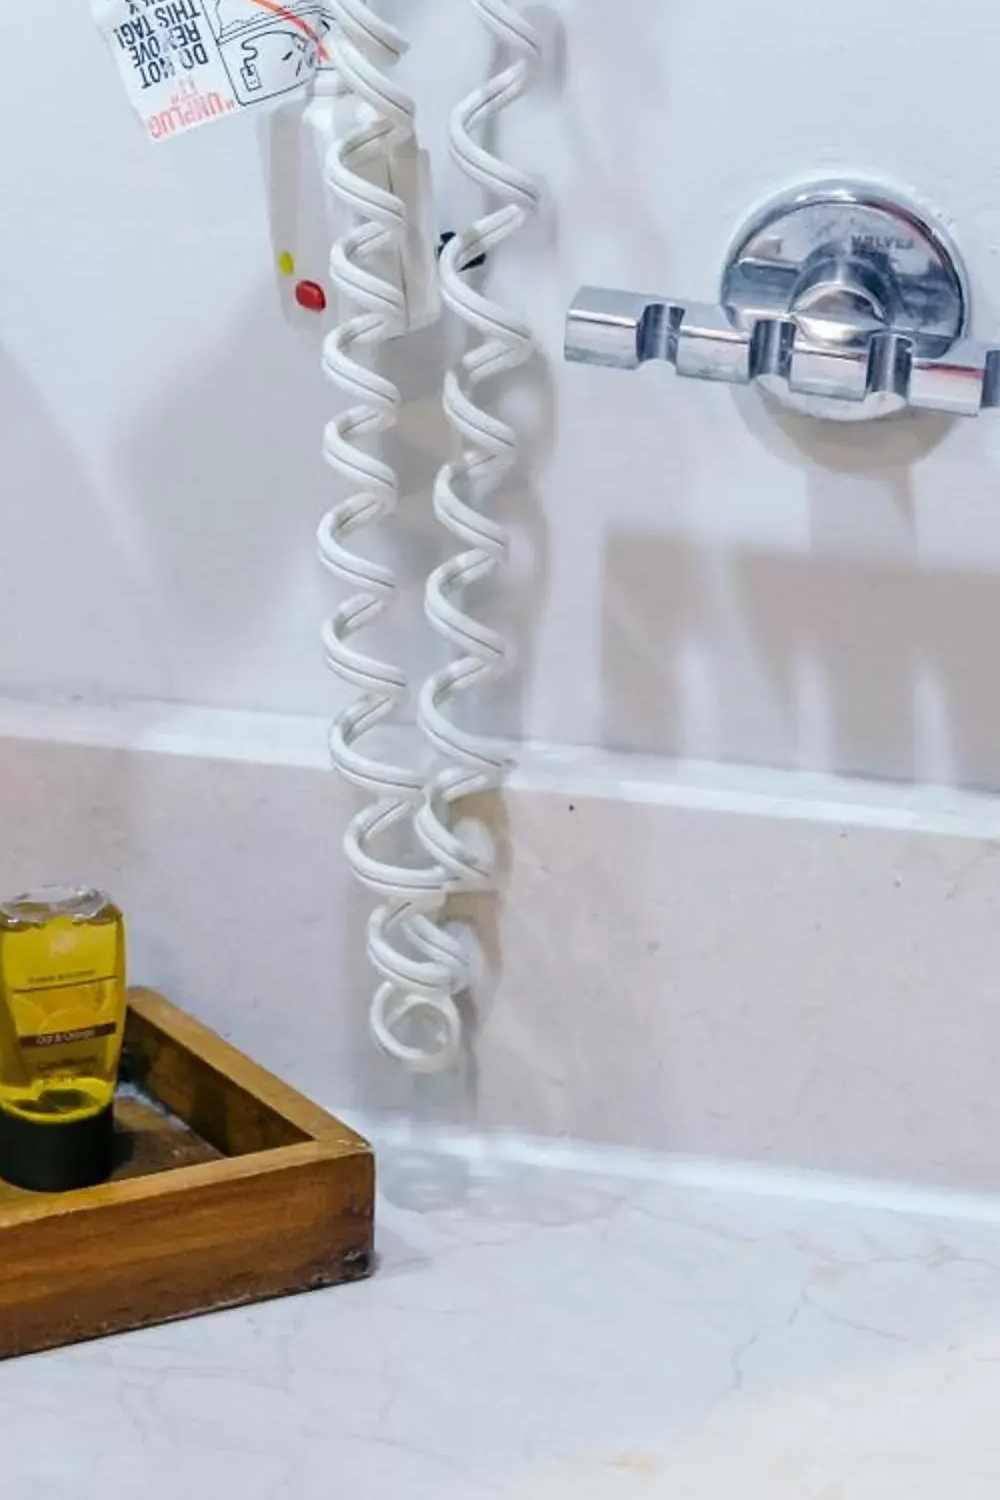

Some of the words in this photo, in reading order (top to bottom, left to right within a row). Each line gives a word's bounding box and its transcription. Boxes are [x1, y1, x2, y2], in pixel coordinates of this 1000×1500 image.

[115, 15, 155, 49] TAG!
[131, 21, 201, 68] REOVE
[179, 43, 208, 70] DO
